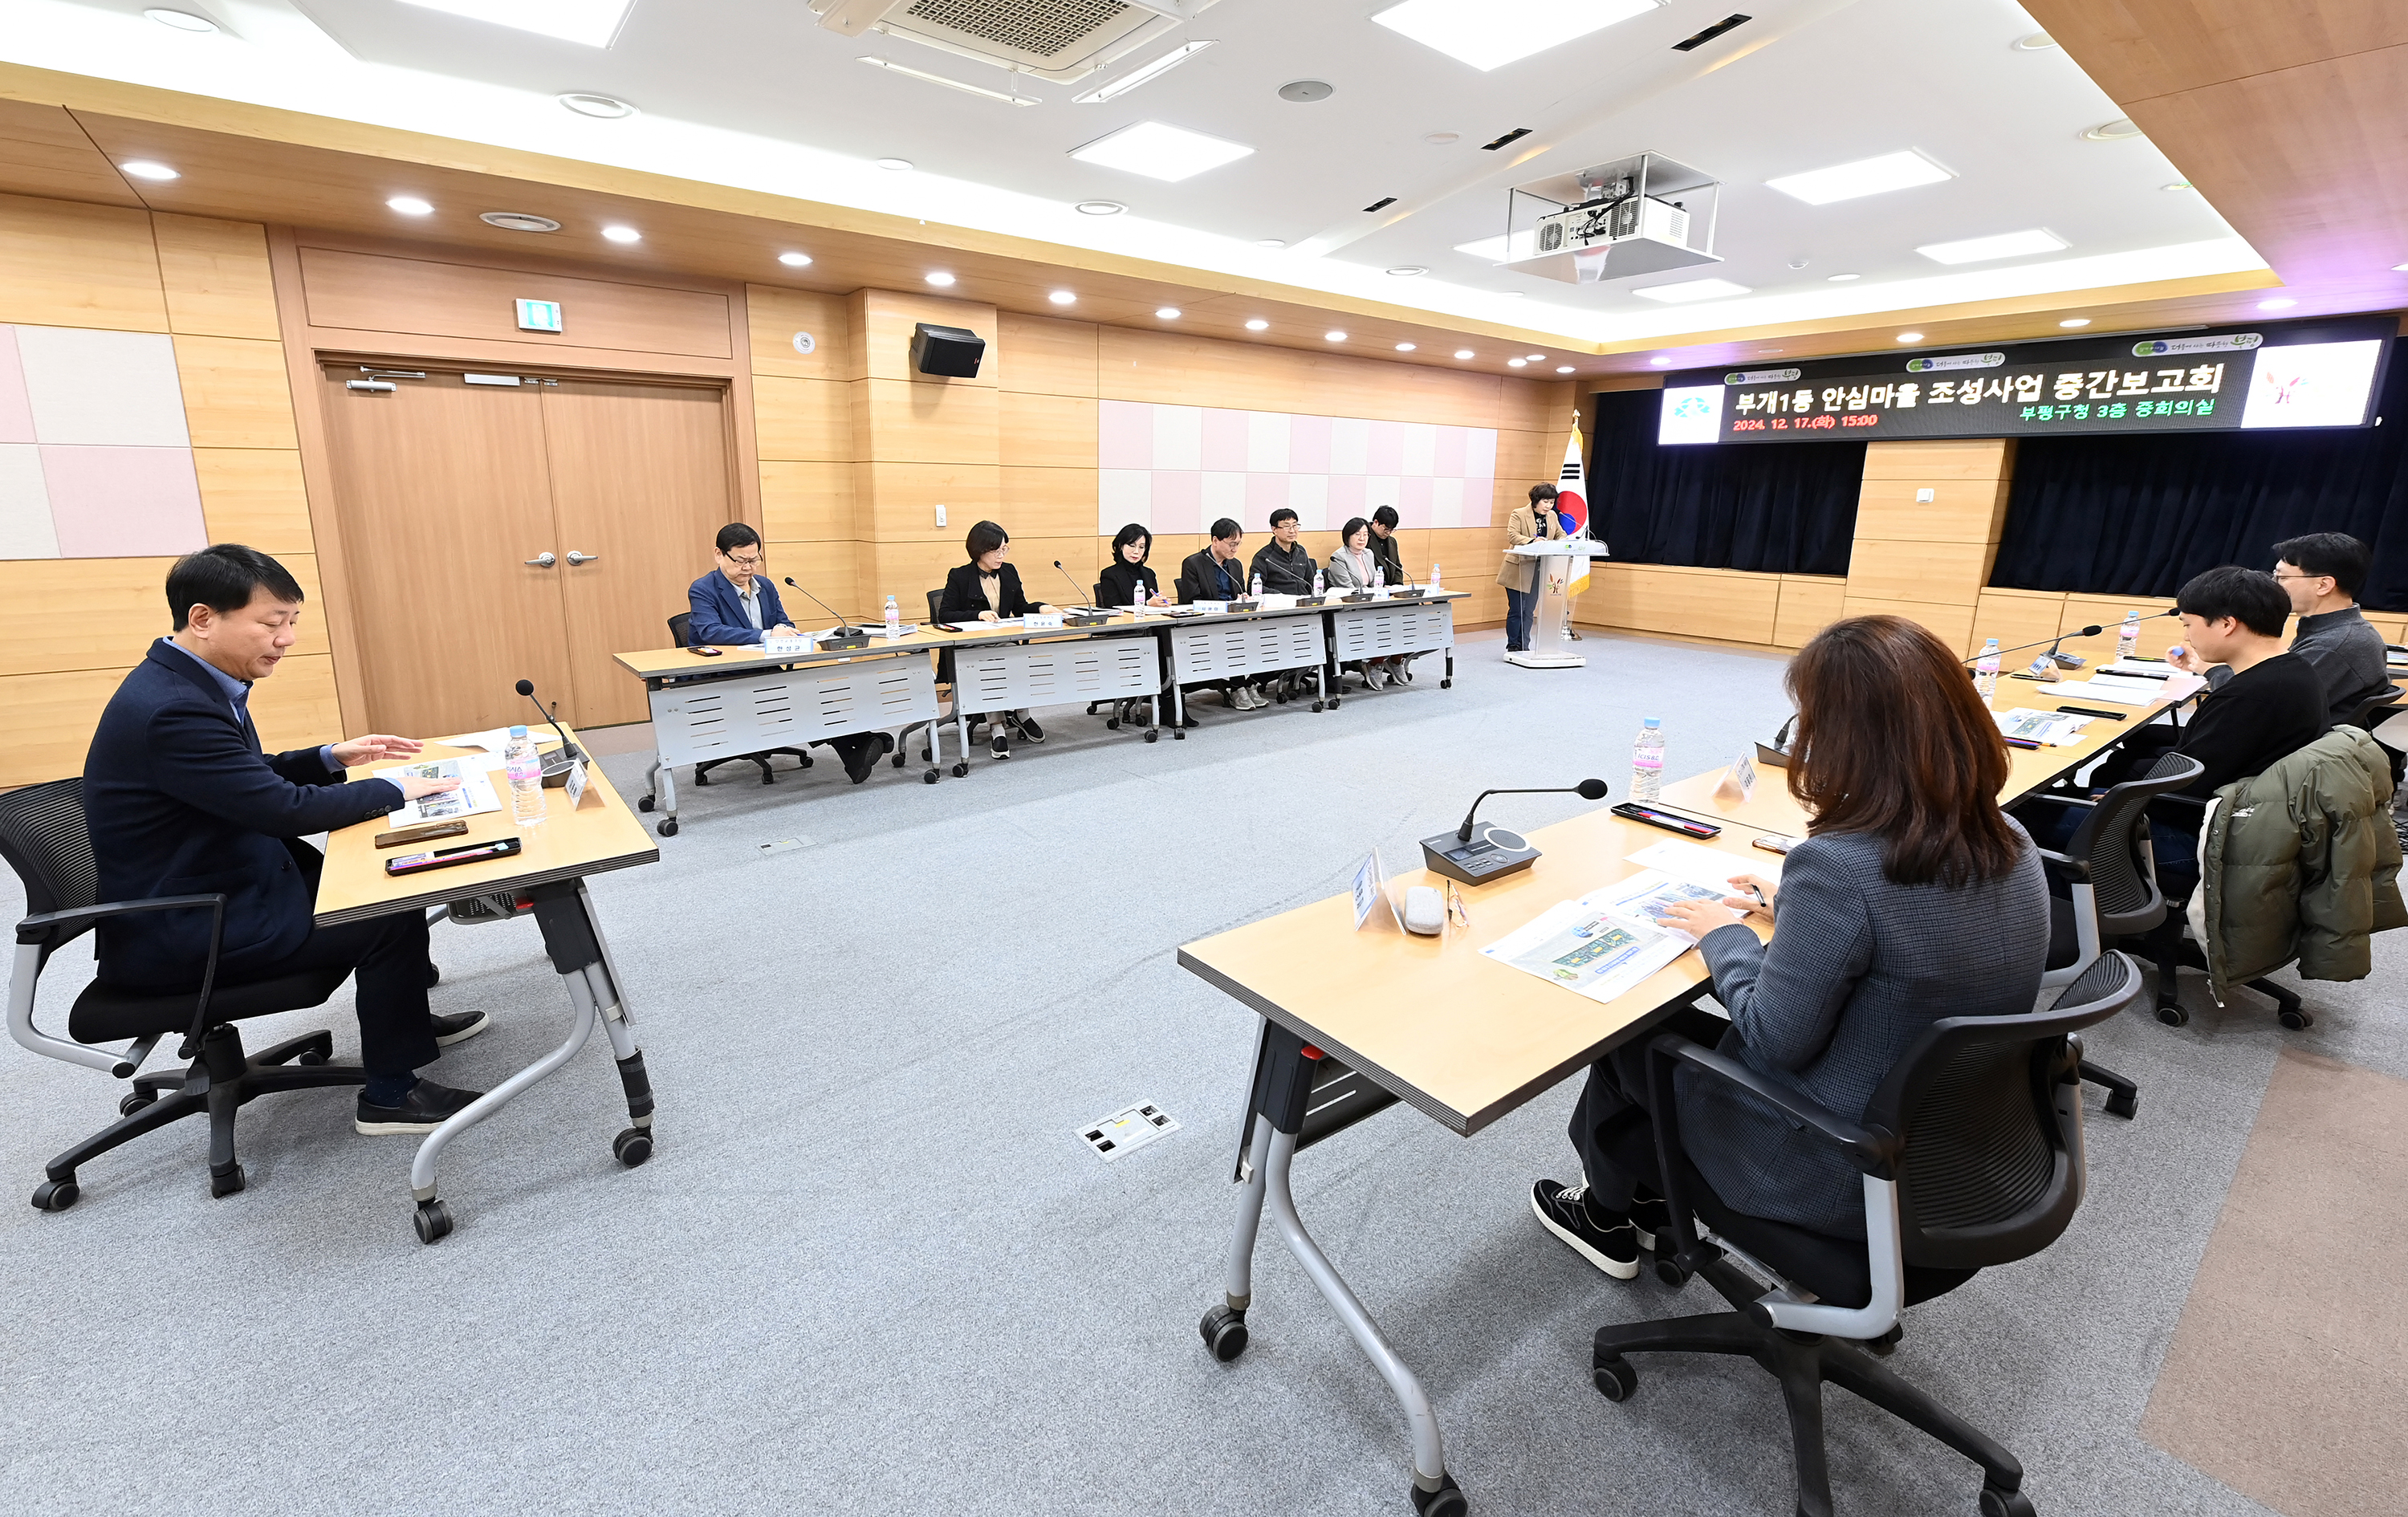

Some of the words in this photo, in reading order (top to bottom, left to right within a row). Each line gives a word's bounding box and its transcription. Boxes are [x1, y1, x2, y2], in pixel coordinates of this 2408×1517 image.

[1735, 389, 1814, 415] 부개1동
[1821, 383, 1921, 412] 안심마을
[1928, 373, 2044, 405] 조성사업
[2053, 363, 2225, 401] 중간보고회
[2020, 403, 2090, 421] 부평구청
[2097, 401, 2128, 419] 3층
[2135, 398, 2215, 418] 중회의실
[1733, 419, 1766, 432] 2024.
[1771, 417, 1789, 430] 12.
[1794, 414, 1837, 430] 17.(화)
[1841, 413, 1879, 427] 15:00
